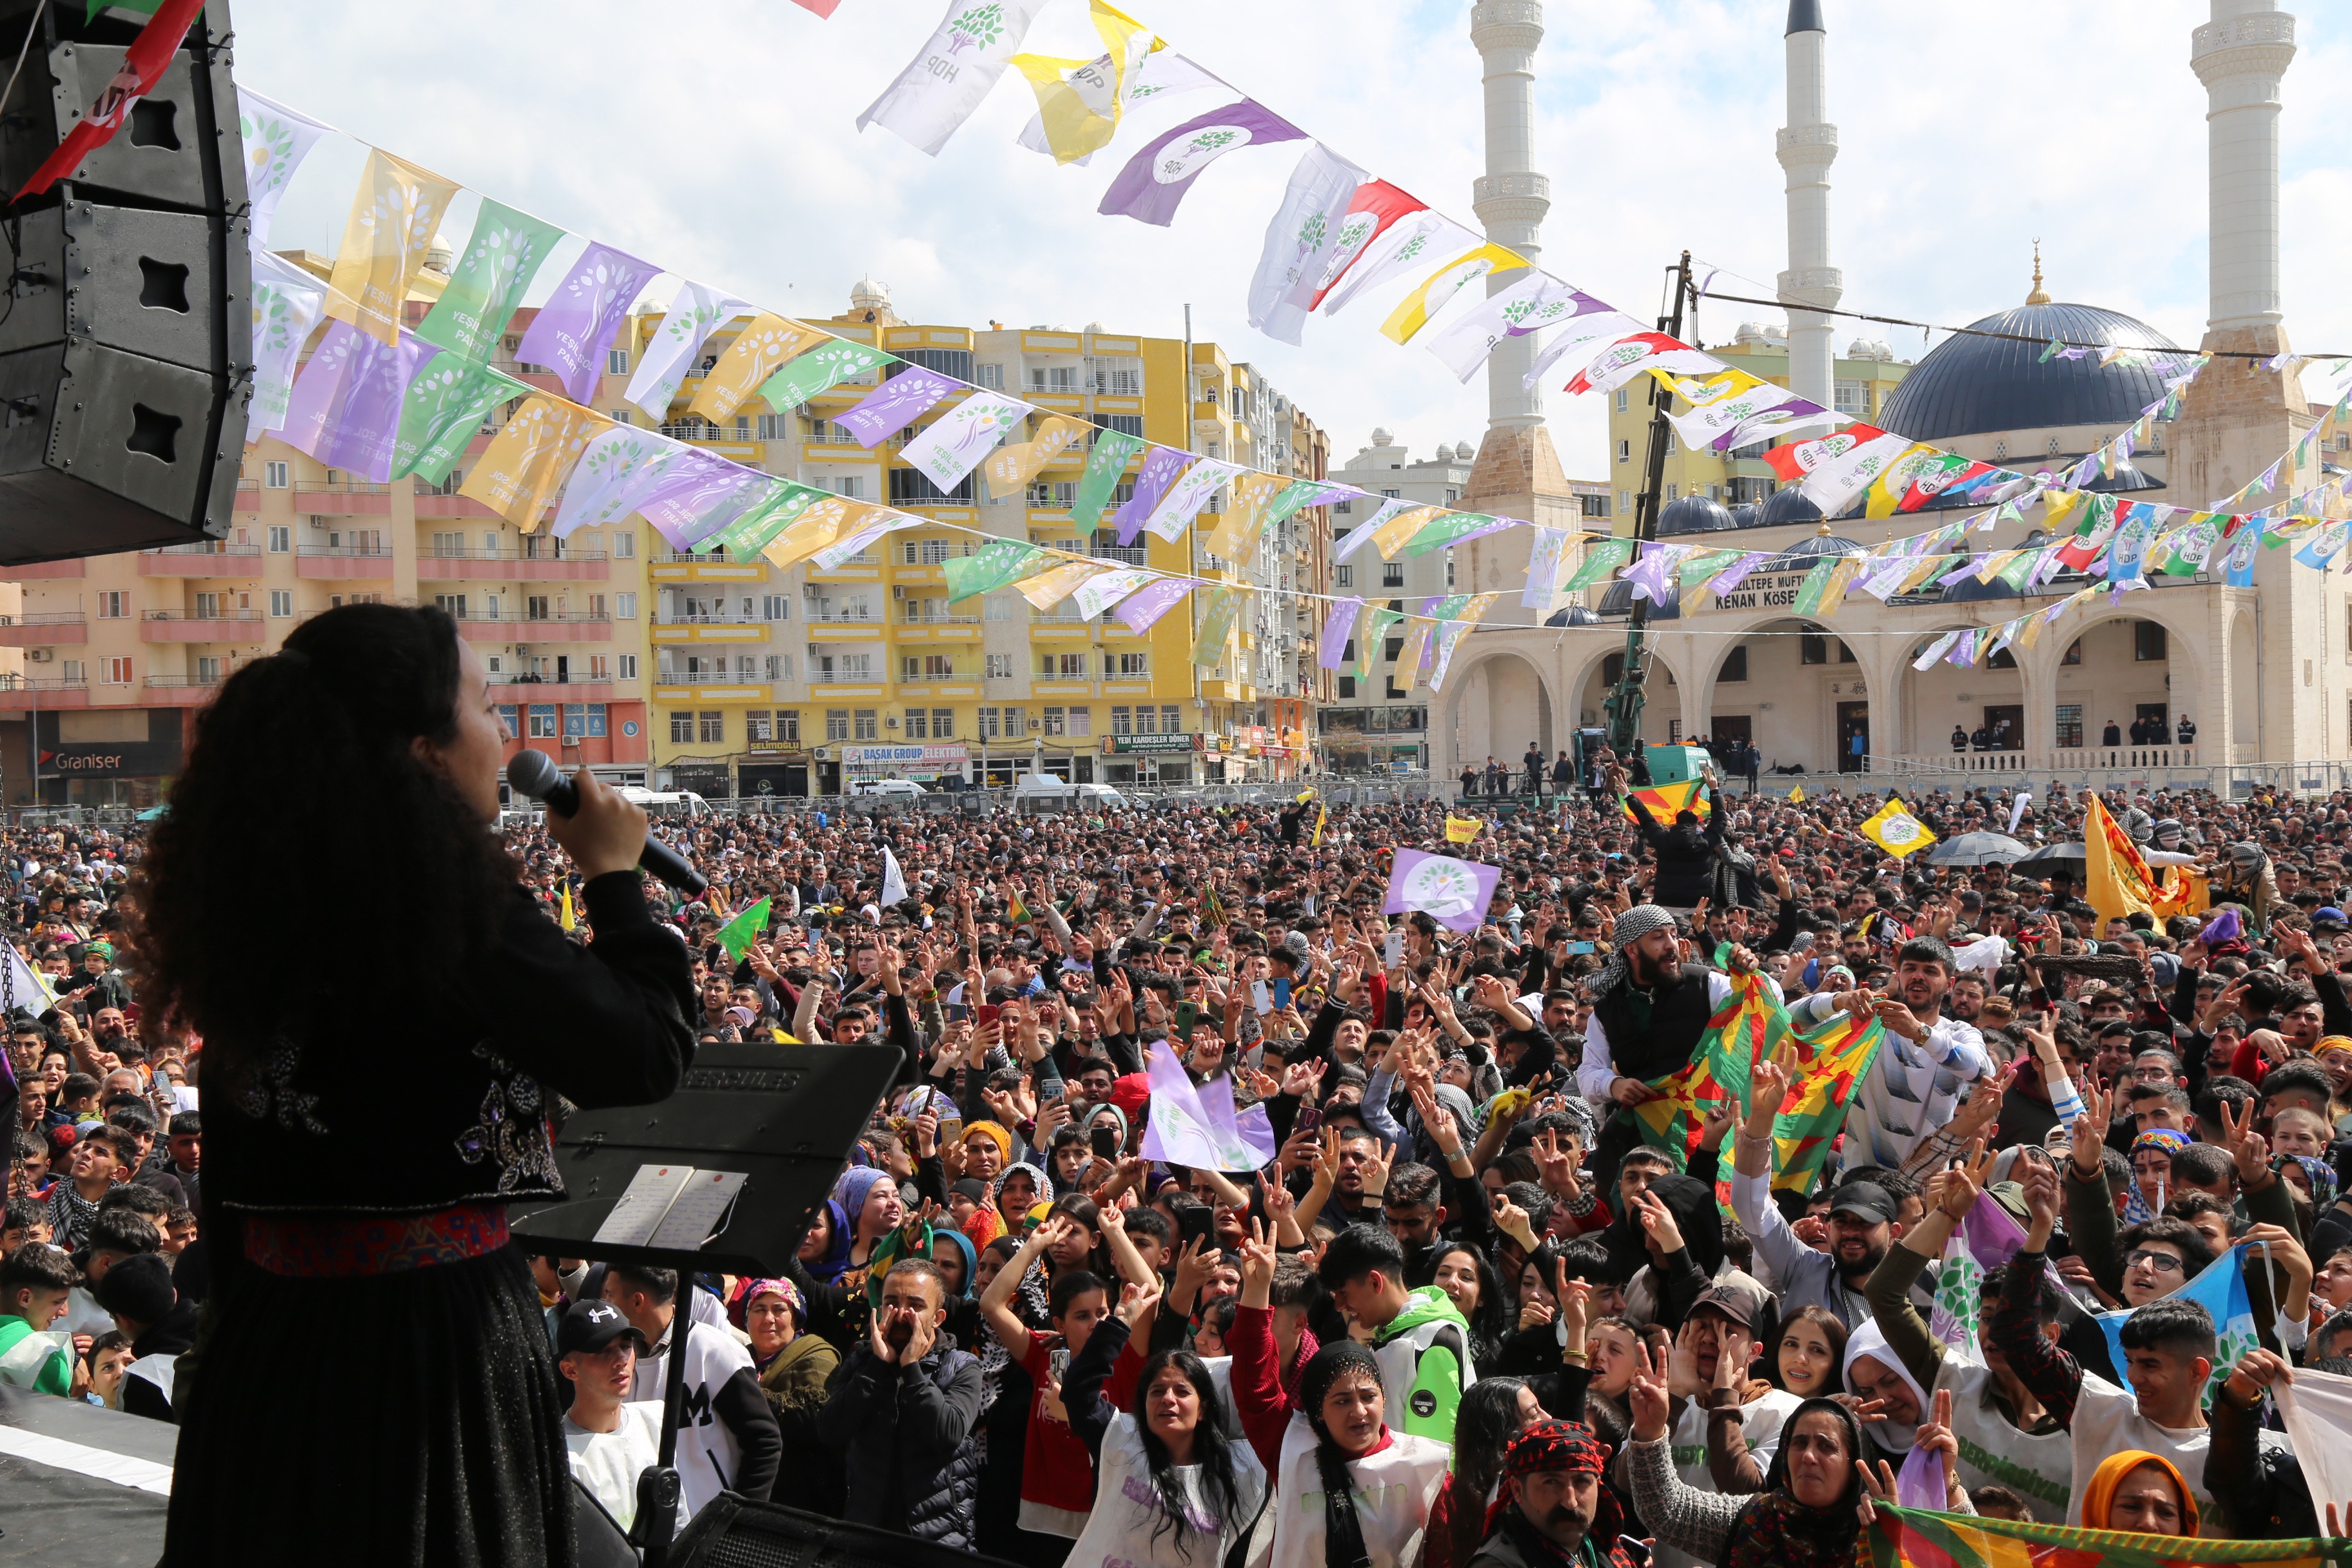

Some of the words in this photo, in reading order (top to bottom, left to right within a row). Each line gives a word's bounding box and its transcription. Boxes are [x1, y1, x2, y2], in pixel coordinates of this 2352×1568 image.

[453, 310, 481, 335] YEŞİL
[455, 331, 487, 357] PARTİ
[556, 329, 580, 357] YEŞİL
[557, 346, 580, 378] PARTİ
[714, 384, 739, 405] YEŞİL
[849, 414, 873, 429] PARTİ
[871, 414, 884, 429] SOL
[932, 443, 954, 466] YEŞİL
[951, 460, 967, 477] SOL
[930, 458, 952, 480] PARTİ
[2183, 551, 2204, 564] HDP
[2314, 545, 2328, 555] HDP
[2117, 553, 2138, 564] HDP
[2232, 560, 2245, 569] HDP
[1716, 593, 1756, 610] KENAN
[750, 741, 799, 750] SELİMOĞLU
[1117, 735, 1131, 744] YEDİ
[1132, 736, 1168, 745] KARDEŞLER
[1169, 734, 1190, 743] DÖNER
[864, 749, 892, 760] BAŞAK
[894, 748, 923, 760] GROUP
[925, 745, 966, 758] ELEKTRİK
[55, 753, 121, 769] Graniser
[1880, 941, 1890, 950] KAYA
